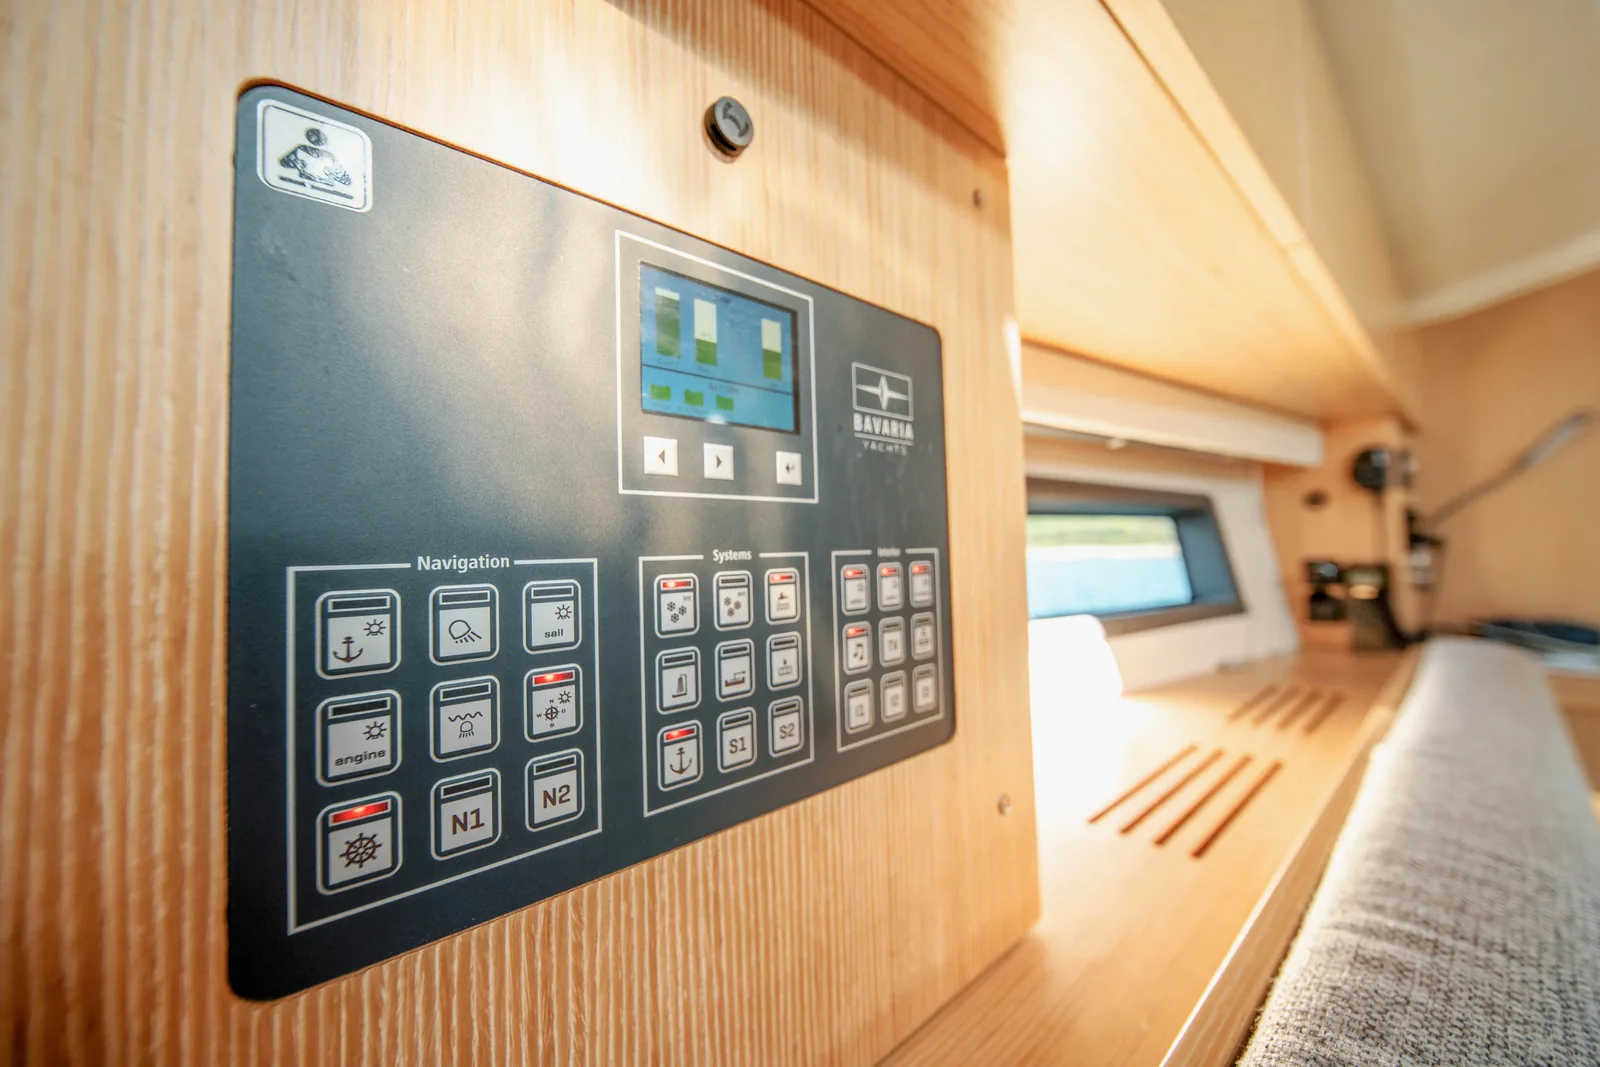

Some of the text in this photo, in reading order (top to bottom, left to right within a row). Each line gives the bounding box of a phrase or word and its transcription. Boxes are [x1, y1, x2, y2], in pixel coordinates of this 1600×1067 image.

[853, 412, 914, 441] BAVARIA
[417, 553, 510, 573] Navigation
[712, 548, 752, 564] Systems
[544, 628, 564, 638] sail
[780, 722, 795, 739] S2
[729, 736, 747, 754] S1
[335, 750, 386, 766] engine
[543, 784, 571, 809] N2
[452, 808, 485, 835] N1
